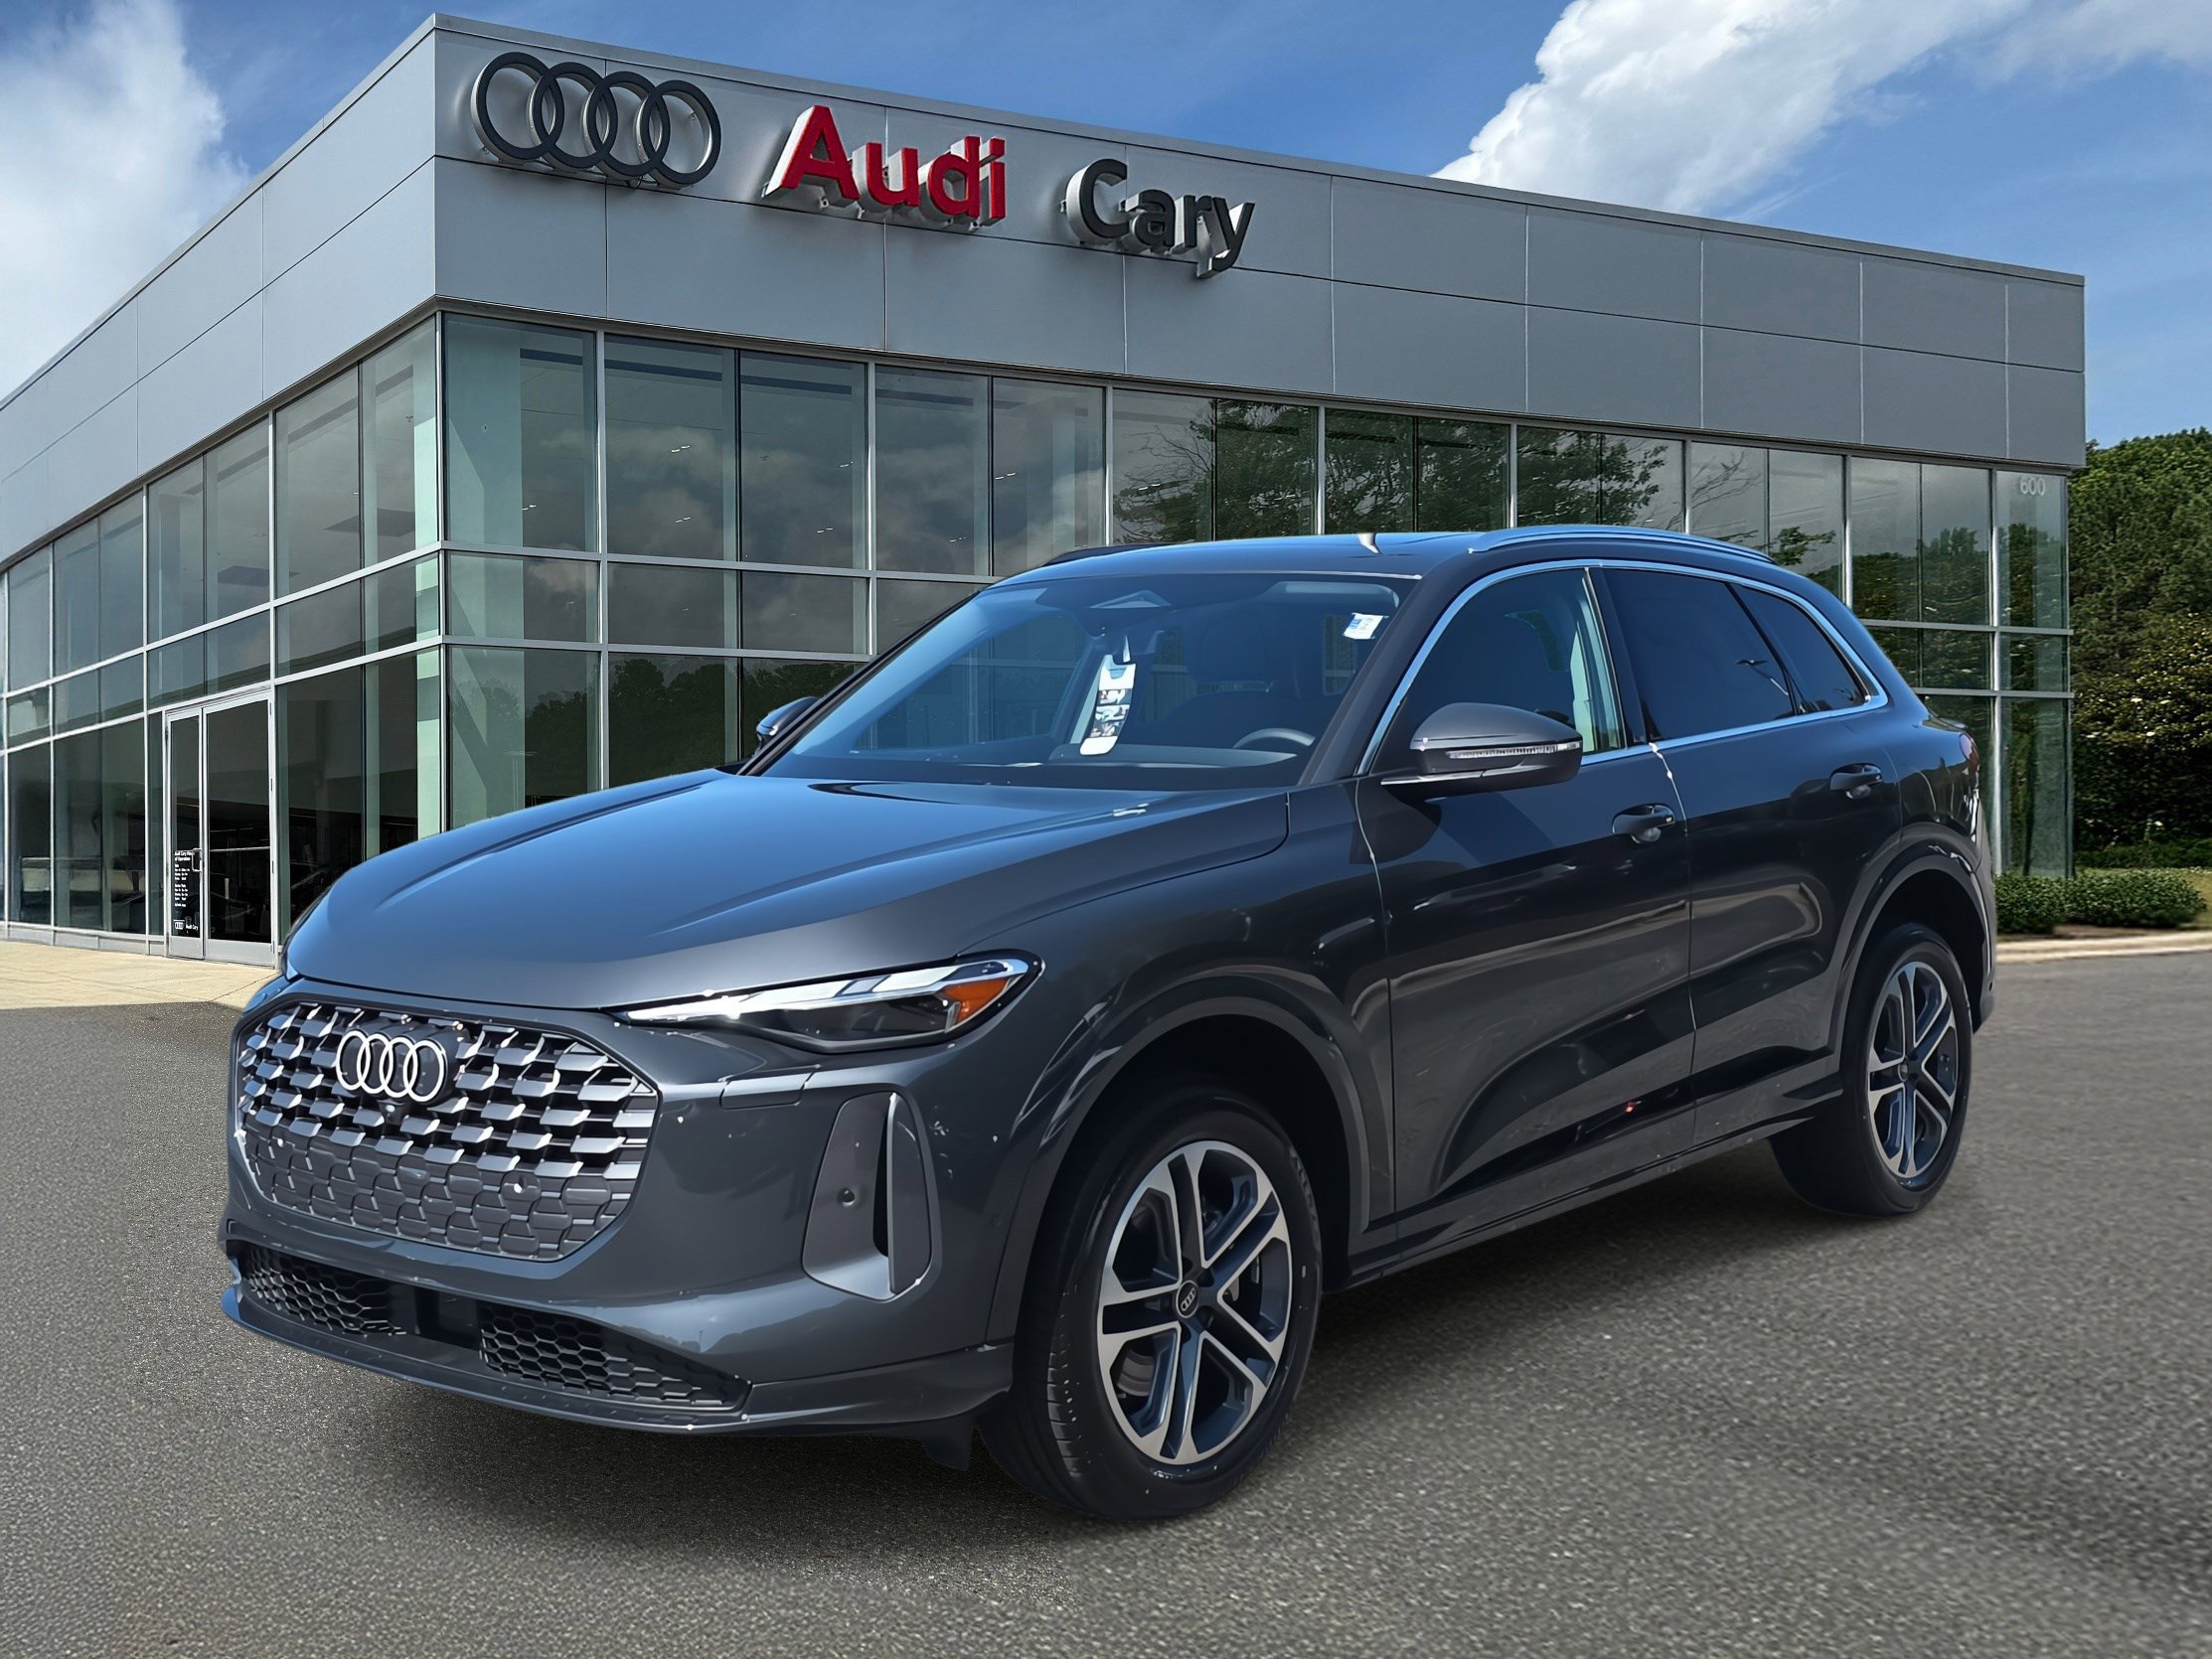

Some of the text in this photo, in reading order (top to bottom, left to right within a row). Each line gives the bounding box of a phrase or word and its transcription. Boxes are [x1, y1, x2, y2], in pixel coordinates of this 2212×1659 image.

[771, 103, 1256, 276] Audi Cary
[2020, 477, 2046, 496] 600
